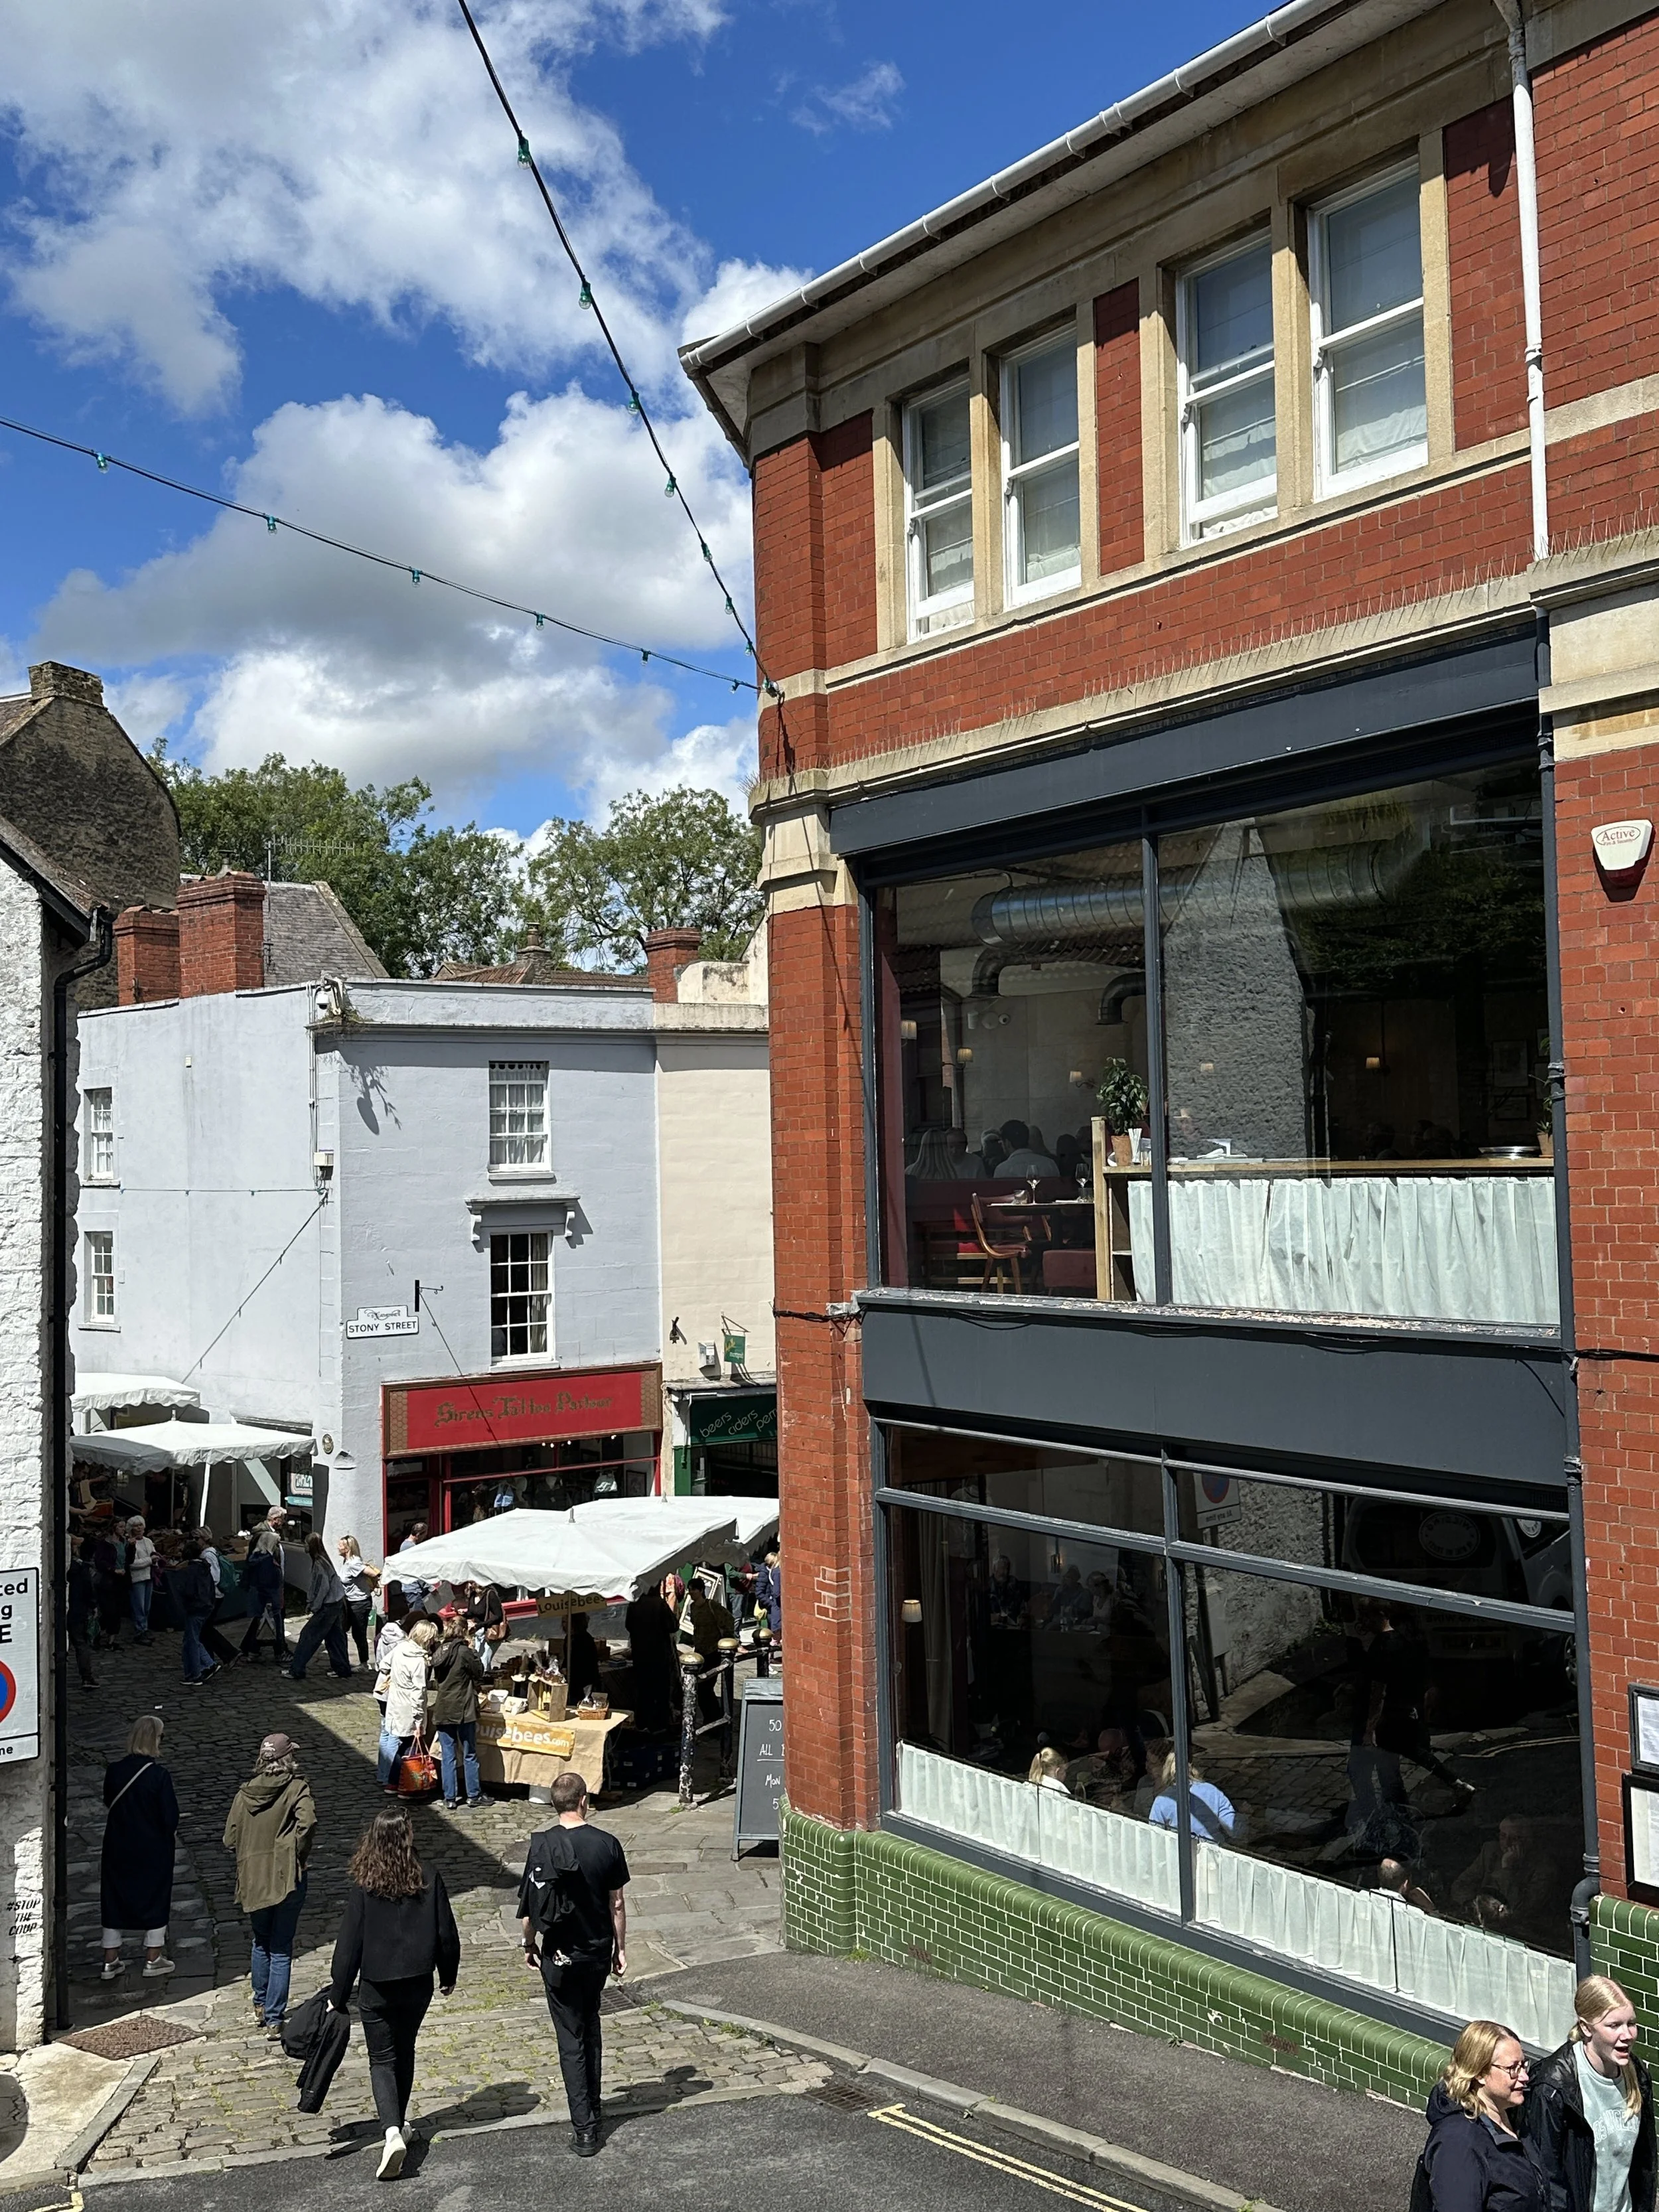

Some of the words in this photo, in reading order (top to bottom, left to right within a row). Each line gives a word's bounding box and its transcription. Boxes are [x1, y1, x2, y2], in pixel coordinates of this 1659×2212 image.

[1601, 830, 1635, 842] Active
[348, 1323, 380, 1333] STONY
[385, 1321, 417, 1331] STREET
[434, 1402, 494, 1428] Sirens
[492, 1395, 550, 1419] Tattoo
[555, 1391, 613, 1414] Parlour
[699, 1412, 732, 1438] beers
[476, 1722, 570, 1747] uisebees.com
[759, 1743, 773, 1756] ALL
[7, 1899, 40, 1911] #STOP
[15, 1912, 33, 1922] THE
[9, 1922, 37, 1936] COUP
